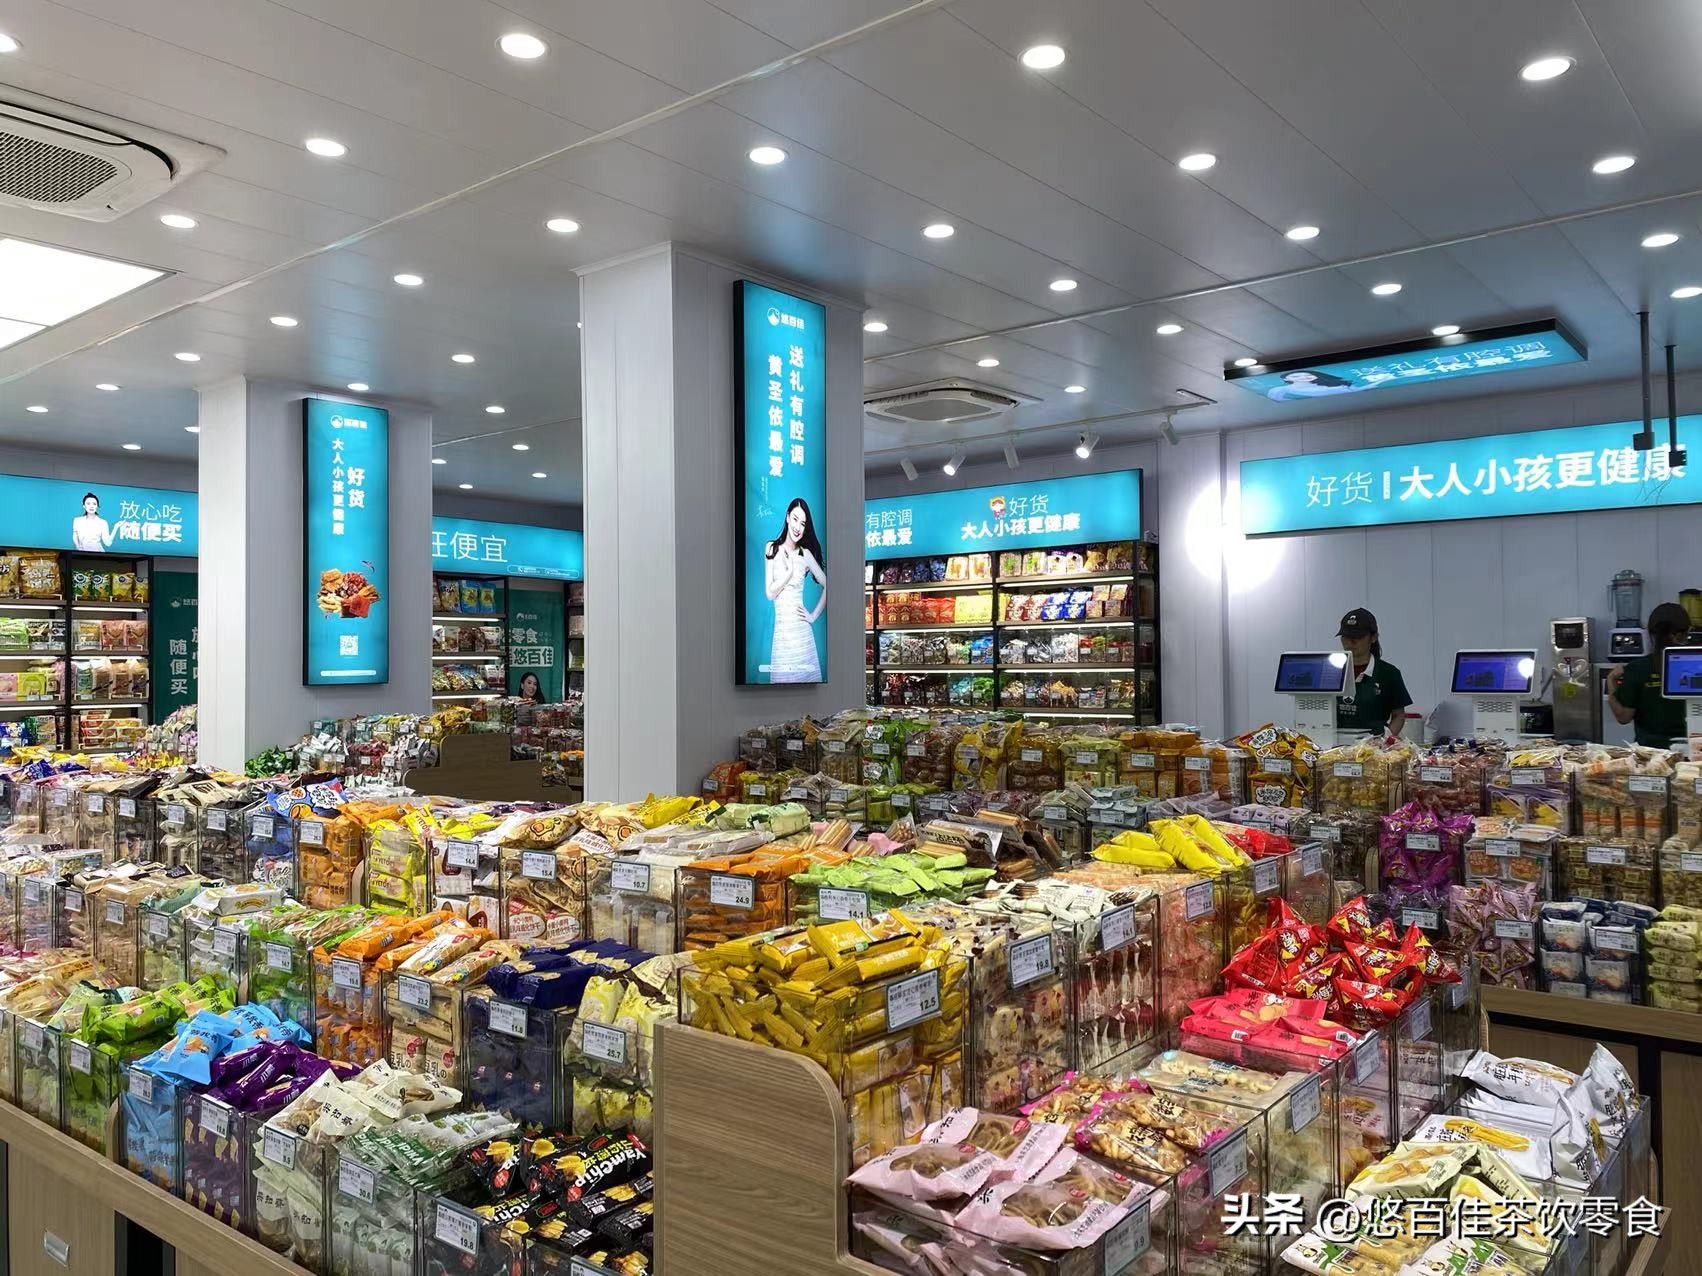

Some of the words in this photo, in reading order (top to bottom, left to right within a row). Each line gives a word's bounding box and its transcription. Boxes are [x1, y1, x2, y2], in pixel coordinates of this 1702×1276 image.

[768, 354, 783, 478] 黄圣依最爱
[789, 344, 804, 466] 送礼有腔调
[1306, 470, 1373, 508] 好货
[1400, 442, 1688, 502] 大人小孩更健康
[347, 466, 365, 508] 好货
[119, 500, 183, 523] 放心吃
[1009, 494, 1049, 516] 好货
[865, 508, 913, 530] 有腔调
[961, 512, 1081, 540] 大人小孩更健康
[119, 521, 183, 543] 随便买
[865, 527, 913, 548] 依最爱
[169, 639, 188, 695] 随便买
[735, 896, 750, 904] 24.9
[848, 910, 864, 918] 14.1
[1036, 959, 1049, 971] 19.8
[920, 997, 936, 1011] 12.5
[607, 1049, 621, 1059] 25.7
[460, 1237, 474, 1250] 19.8
